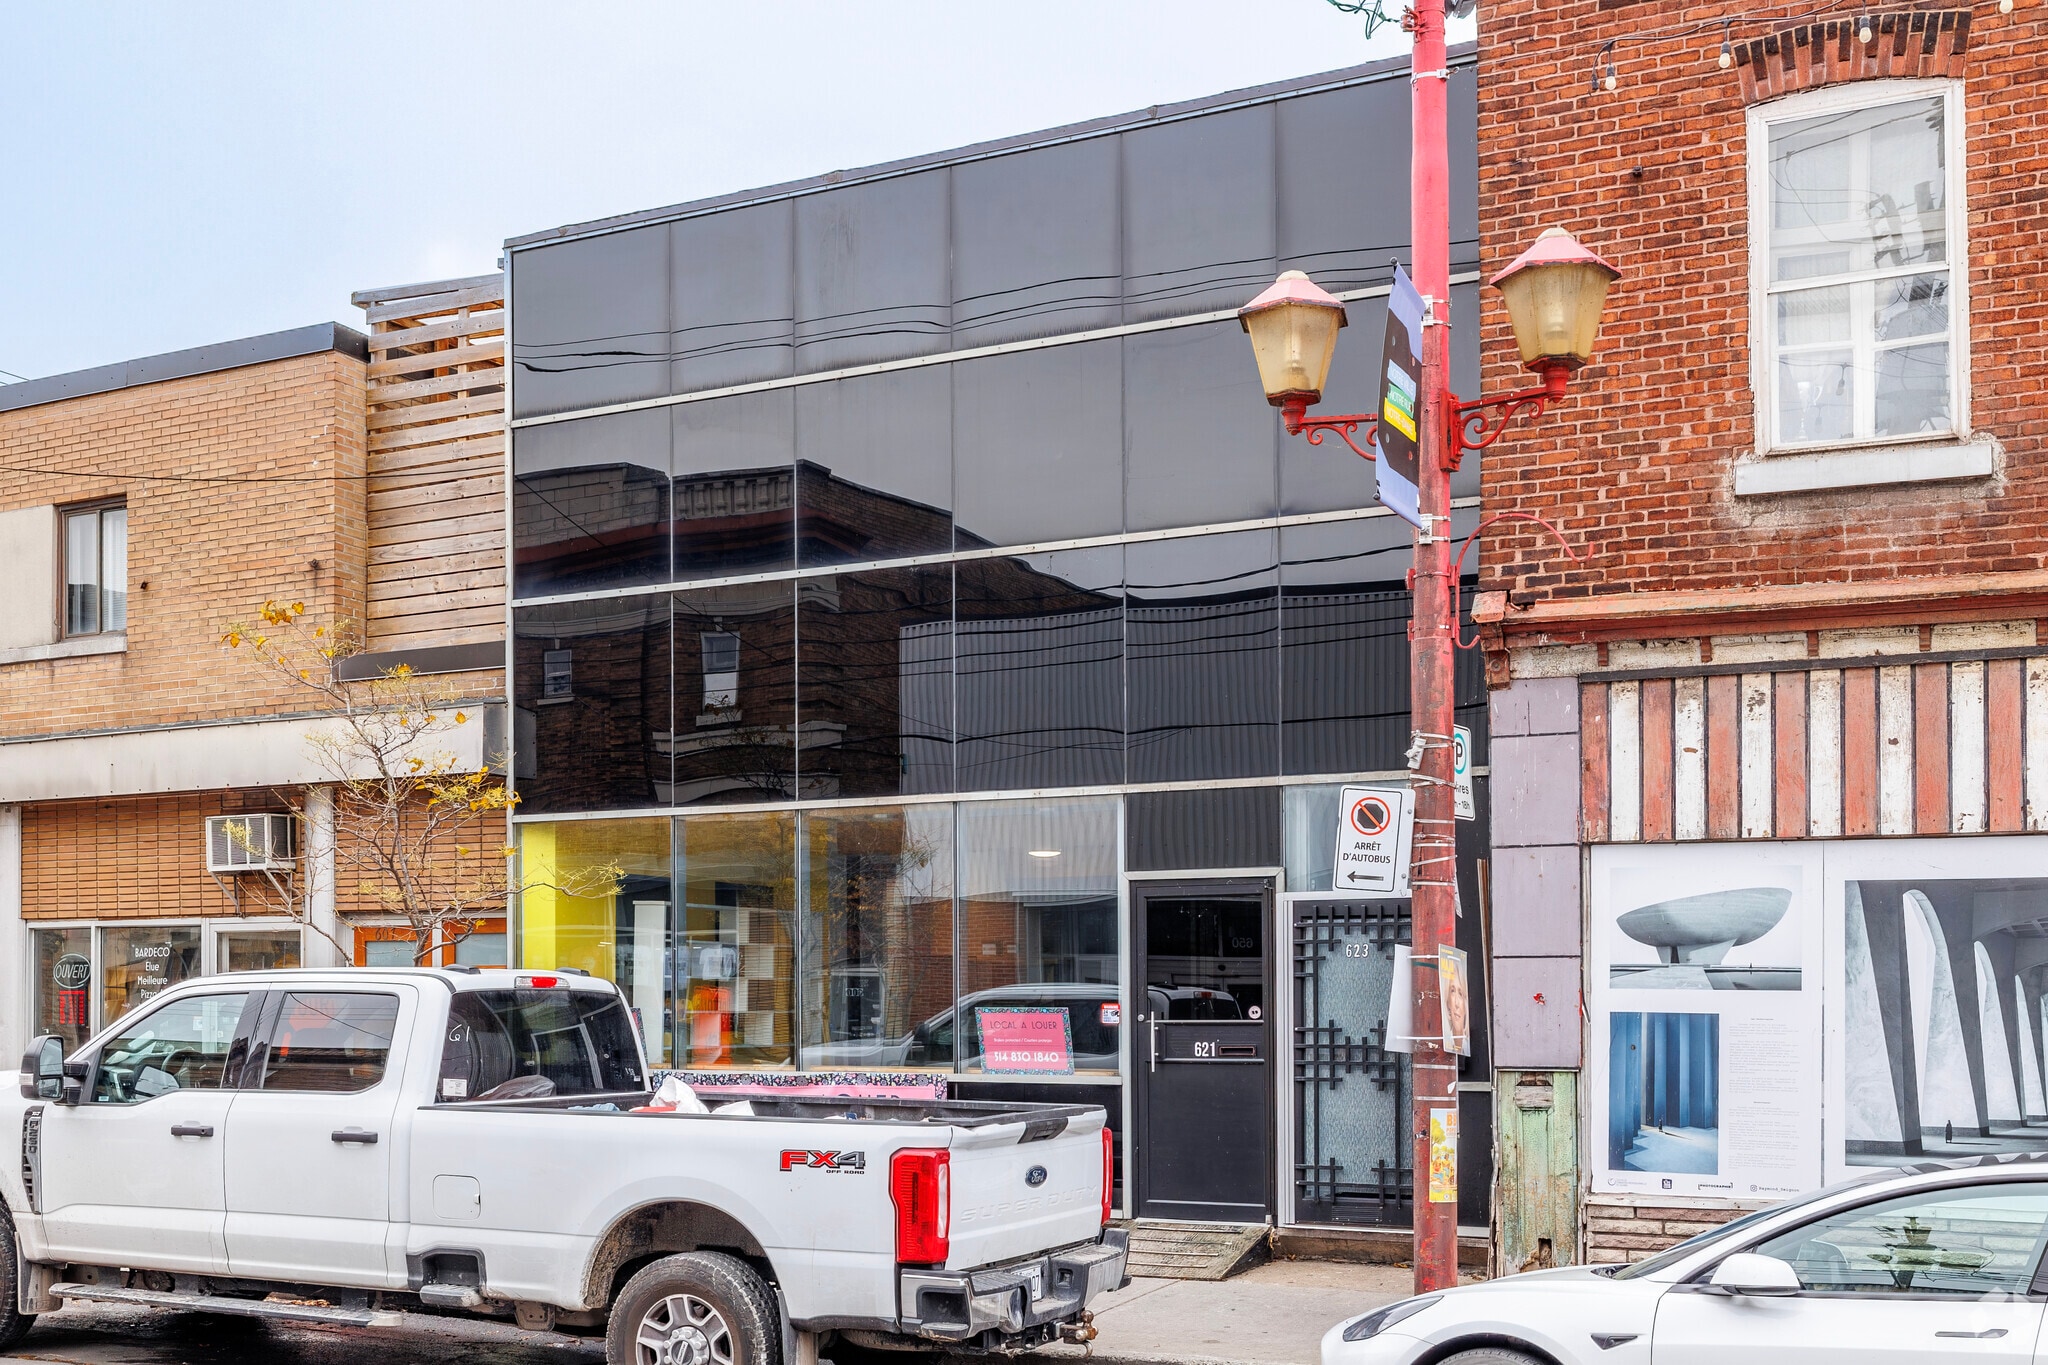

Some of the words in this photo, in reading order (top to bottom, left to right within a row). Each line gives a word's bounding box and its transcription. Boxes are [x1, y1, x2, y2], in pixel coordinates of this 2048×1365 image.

[1455, 741, 1463, 766] P
[1354, 840, 1381, 852] ARRÊT
[1342, 852, 1391, 864] D'AUTOBUS
[1346, 944, 1369, 958] 623
[55, 963, 90, 979] OUVERT
[137, 975, 168, 986] Meilleure
[990, 1020, 1017, 1030] LOCAL
[1031, 1021, 1057, 1030] LOUER
[1194, 1041, 1216, 1057] 621
[994, 1051, 1008, 1062] 514
[1010, 1051, 1031, 1062] 830
[1033, 1051, 1059, 1063] 1840
[779, 1149, 866, 1172] FX4
[961, 1196, 1042, 1223] SUPER
[1047, 1185, 1097, 1207] DUTY
